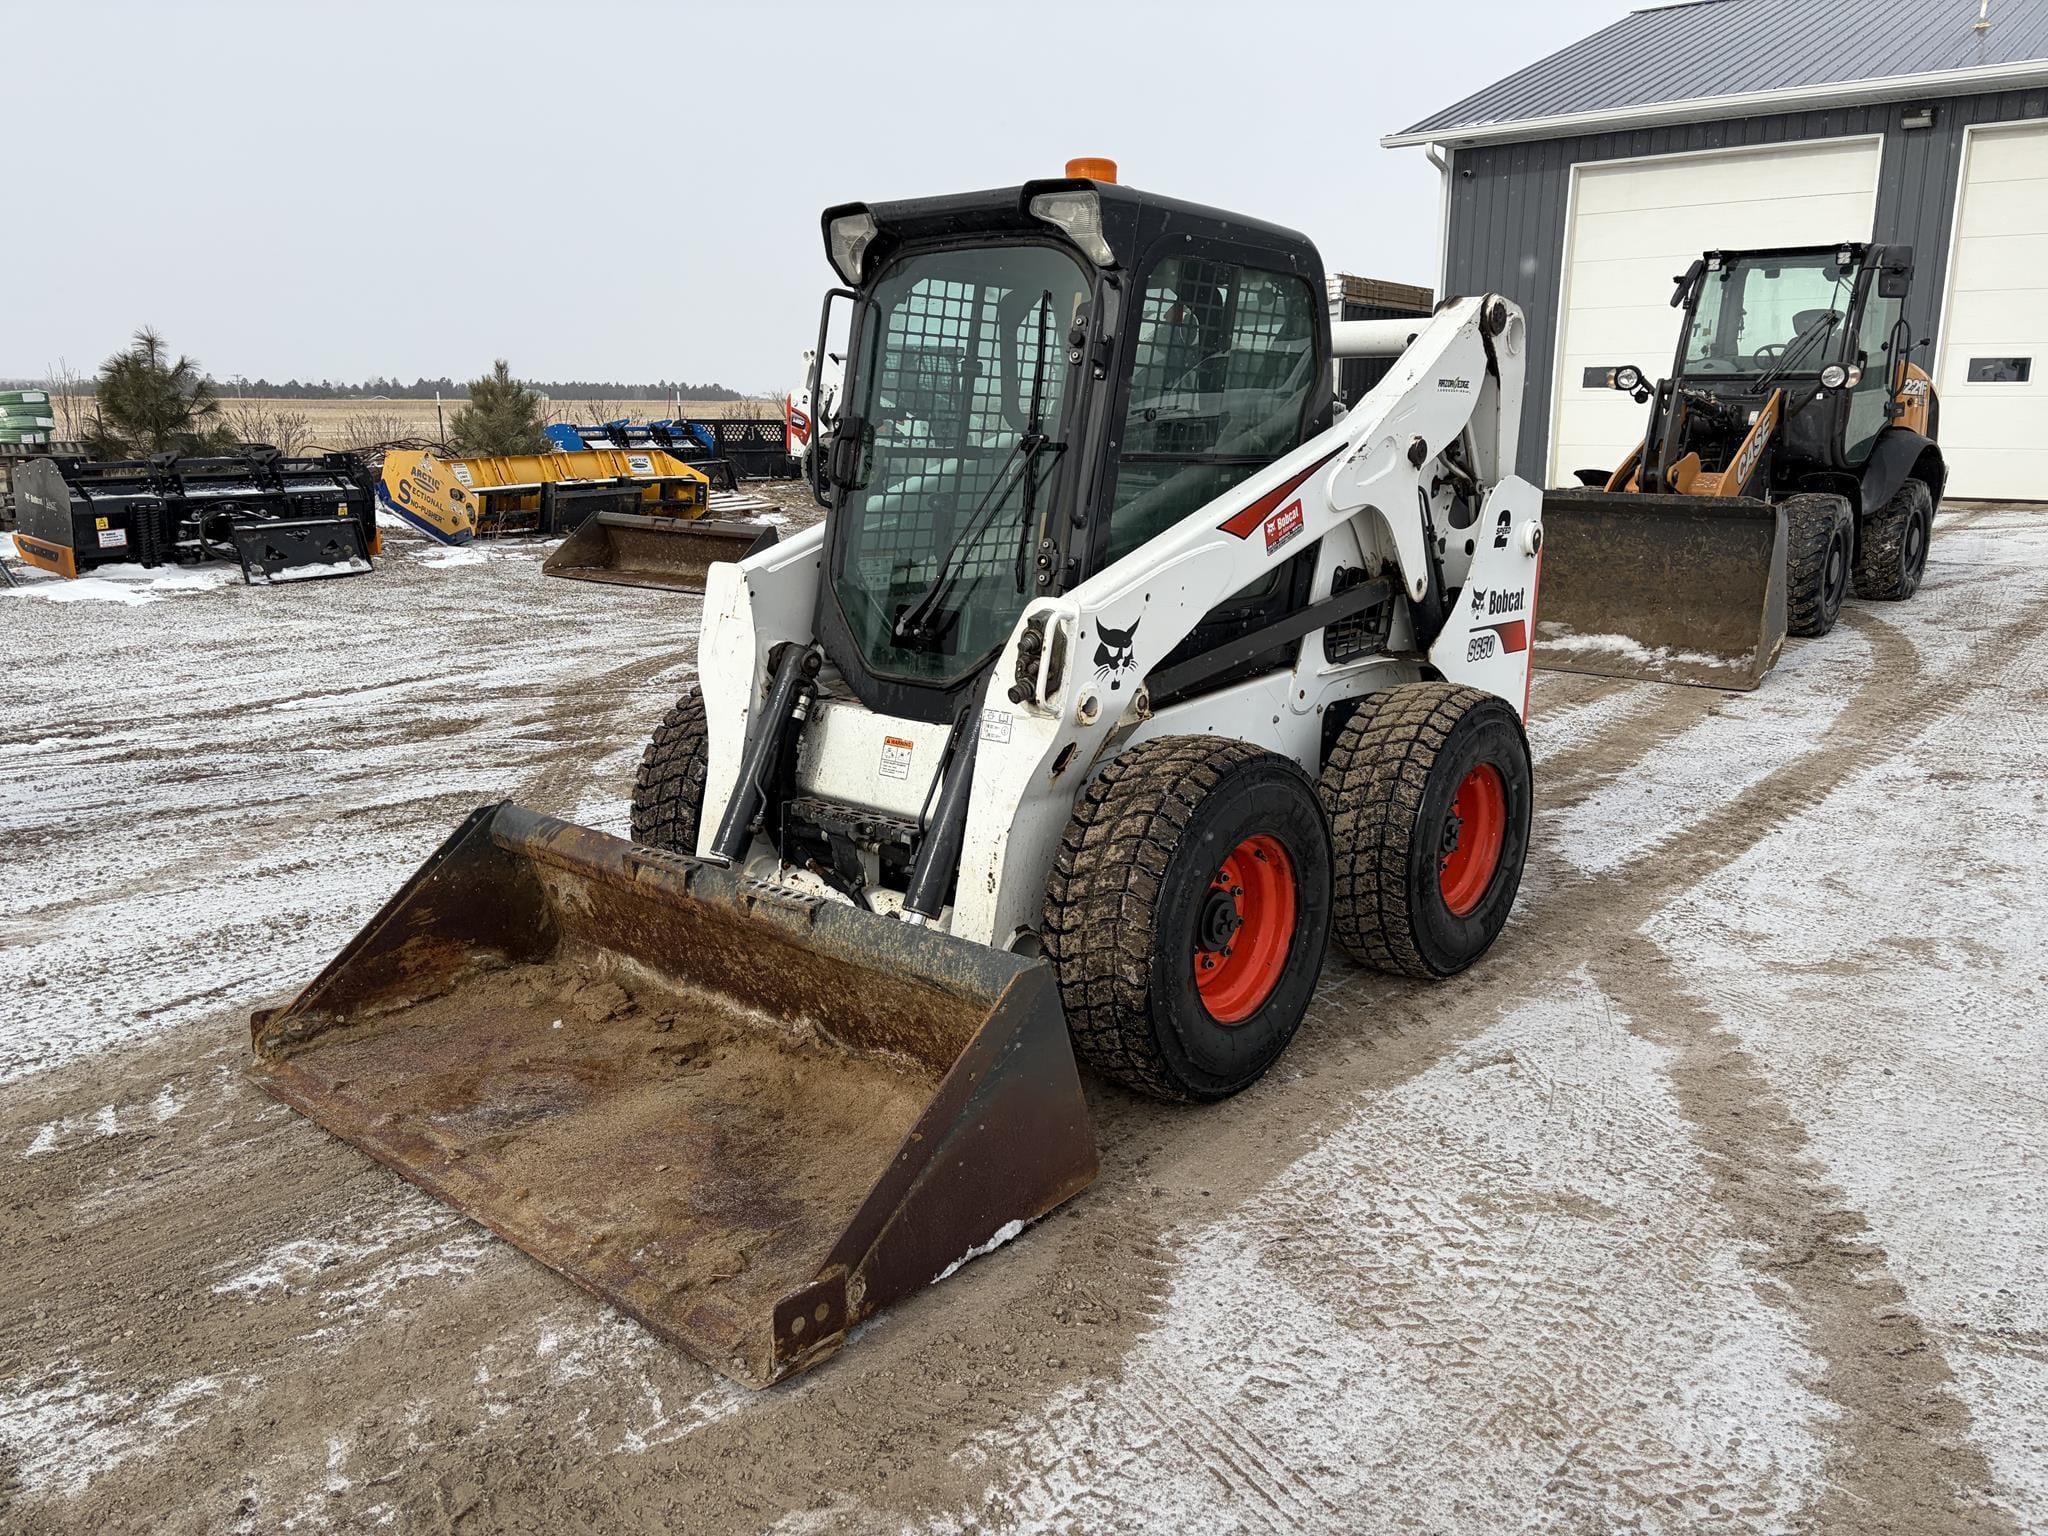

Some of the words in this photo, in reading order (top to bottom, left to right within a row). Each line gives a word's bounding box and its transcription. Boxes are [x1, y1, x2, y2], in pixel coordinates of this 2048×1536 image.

[1737, 411, 1771, 485] CASE
[410, 466, 441, 490] ARCTIC
[1277, 506, 1299, 530] Bobcat
[1495, 526, 1511, 535] SPEED
[1488, 587, 1525, 615] Bobcat
[1467, 635, 1495, 663] S650
